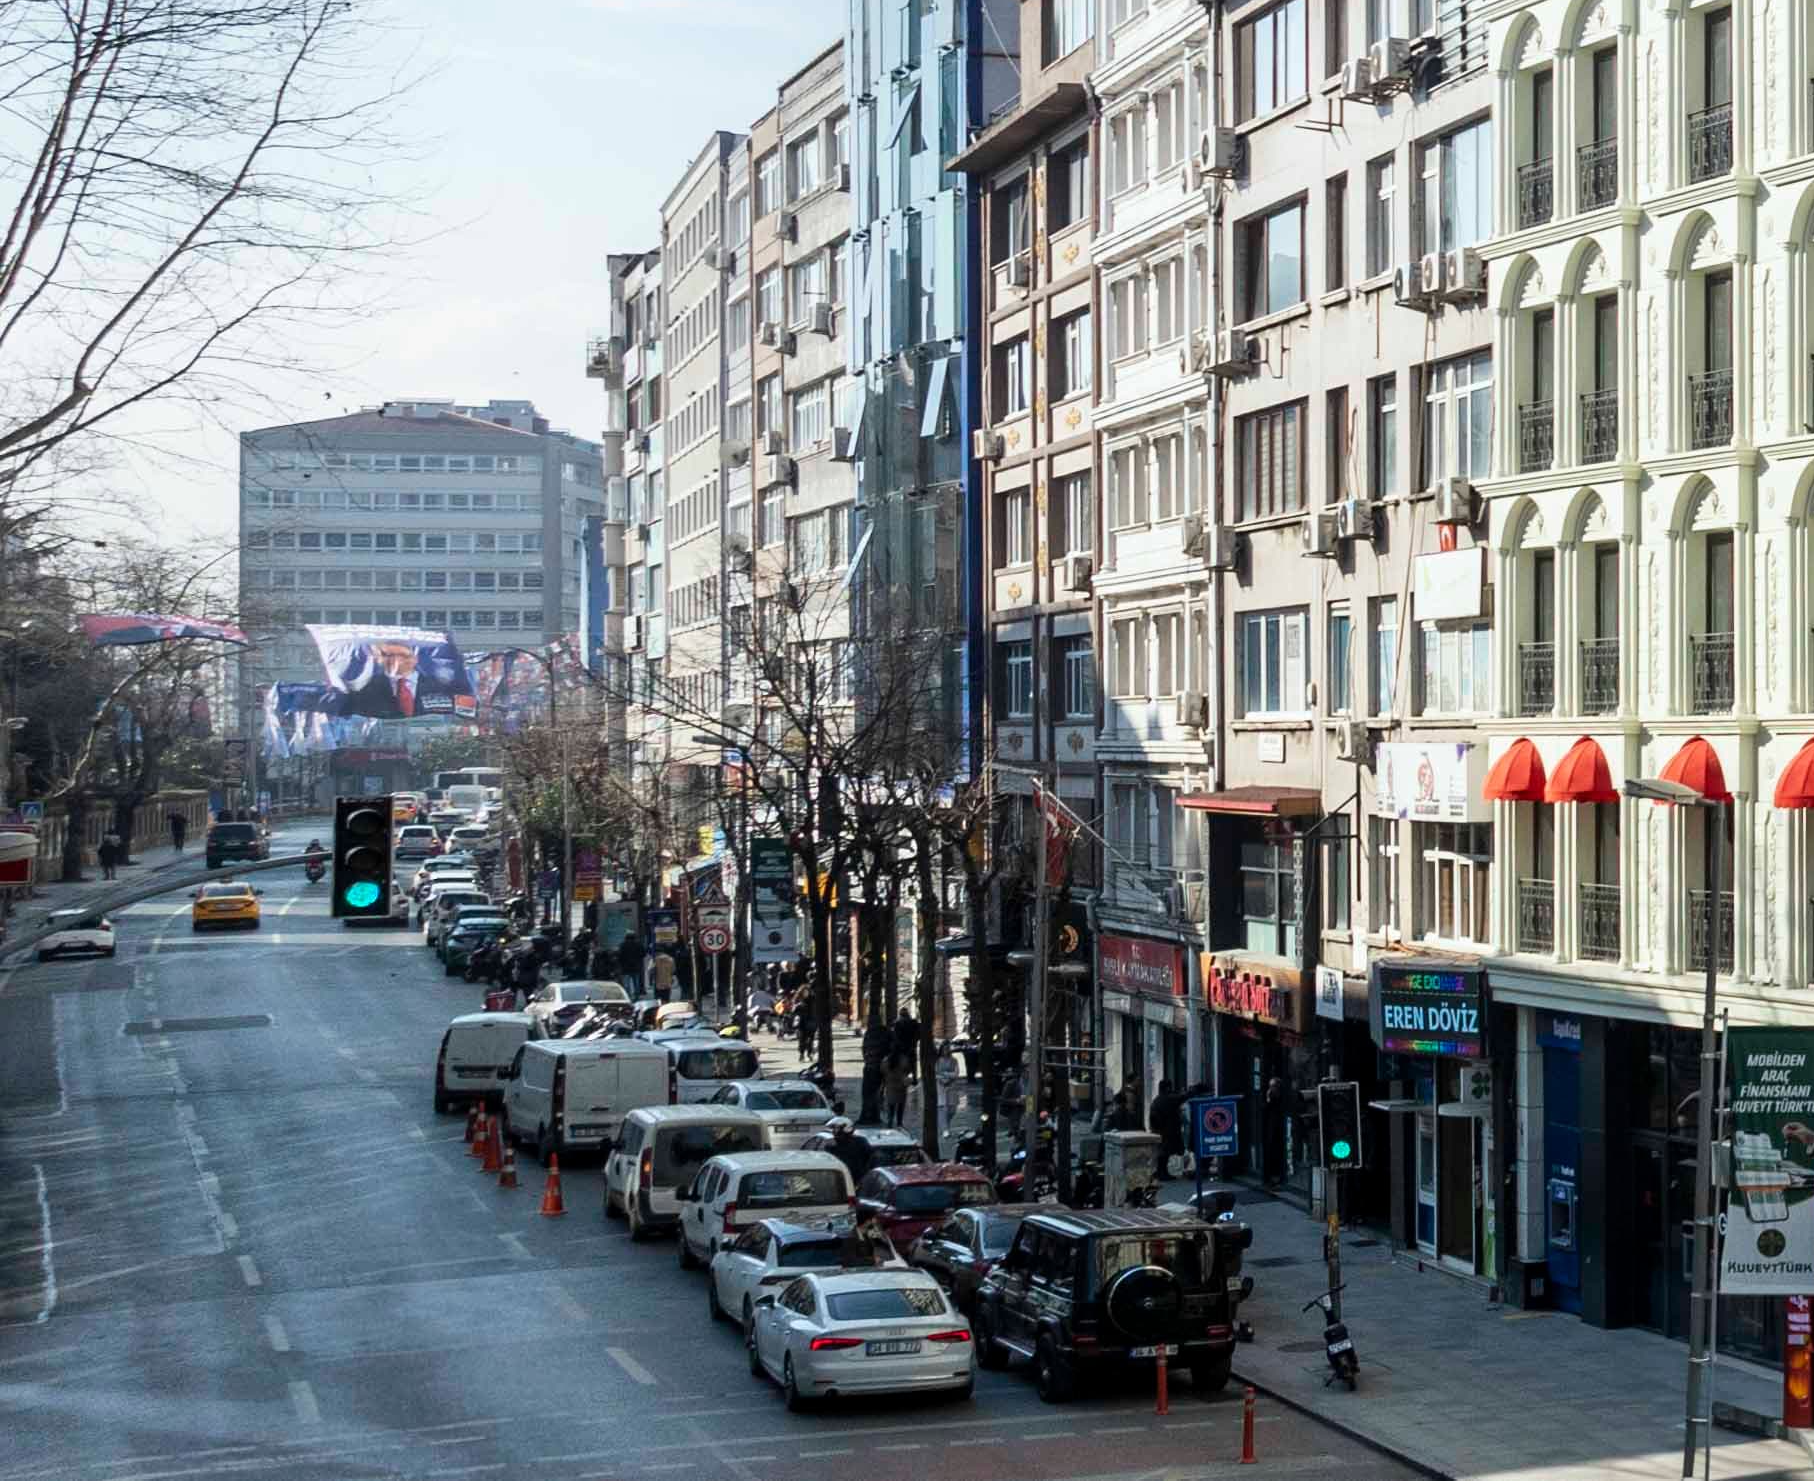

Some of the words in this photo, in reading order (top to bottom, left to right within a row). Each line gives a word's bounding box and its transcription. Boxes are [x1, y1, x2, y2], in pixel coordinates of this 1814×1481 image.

[707, 933, 723, 946] 30
[1384, 1005, 1424, 1030] EREN
[1427, 1001, 1479, 1033] DÖVİZ
[1746, 1050, 1806, 1067] MOBİLDEN
[1760, 1069, 1792, 1085] ARAÇ
[1740, 1081, 1812, 1098] FİNANSMANI
[1731, 1100, 1774, 1114] KUVEYT
